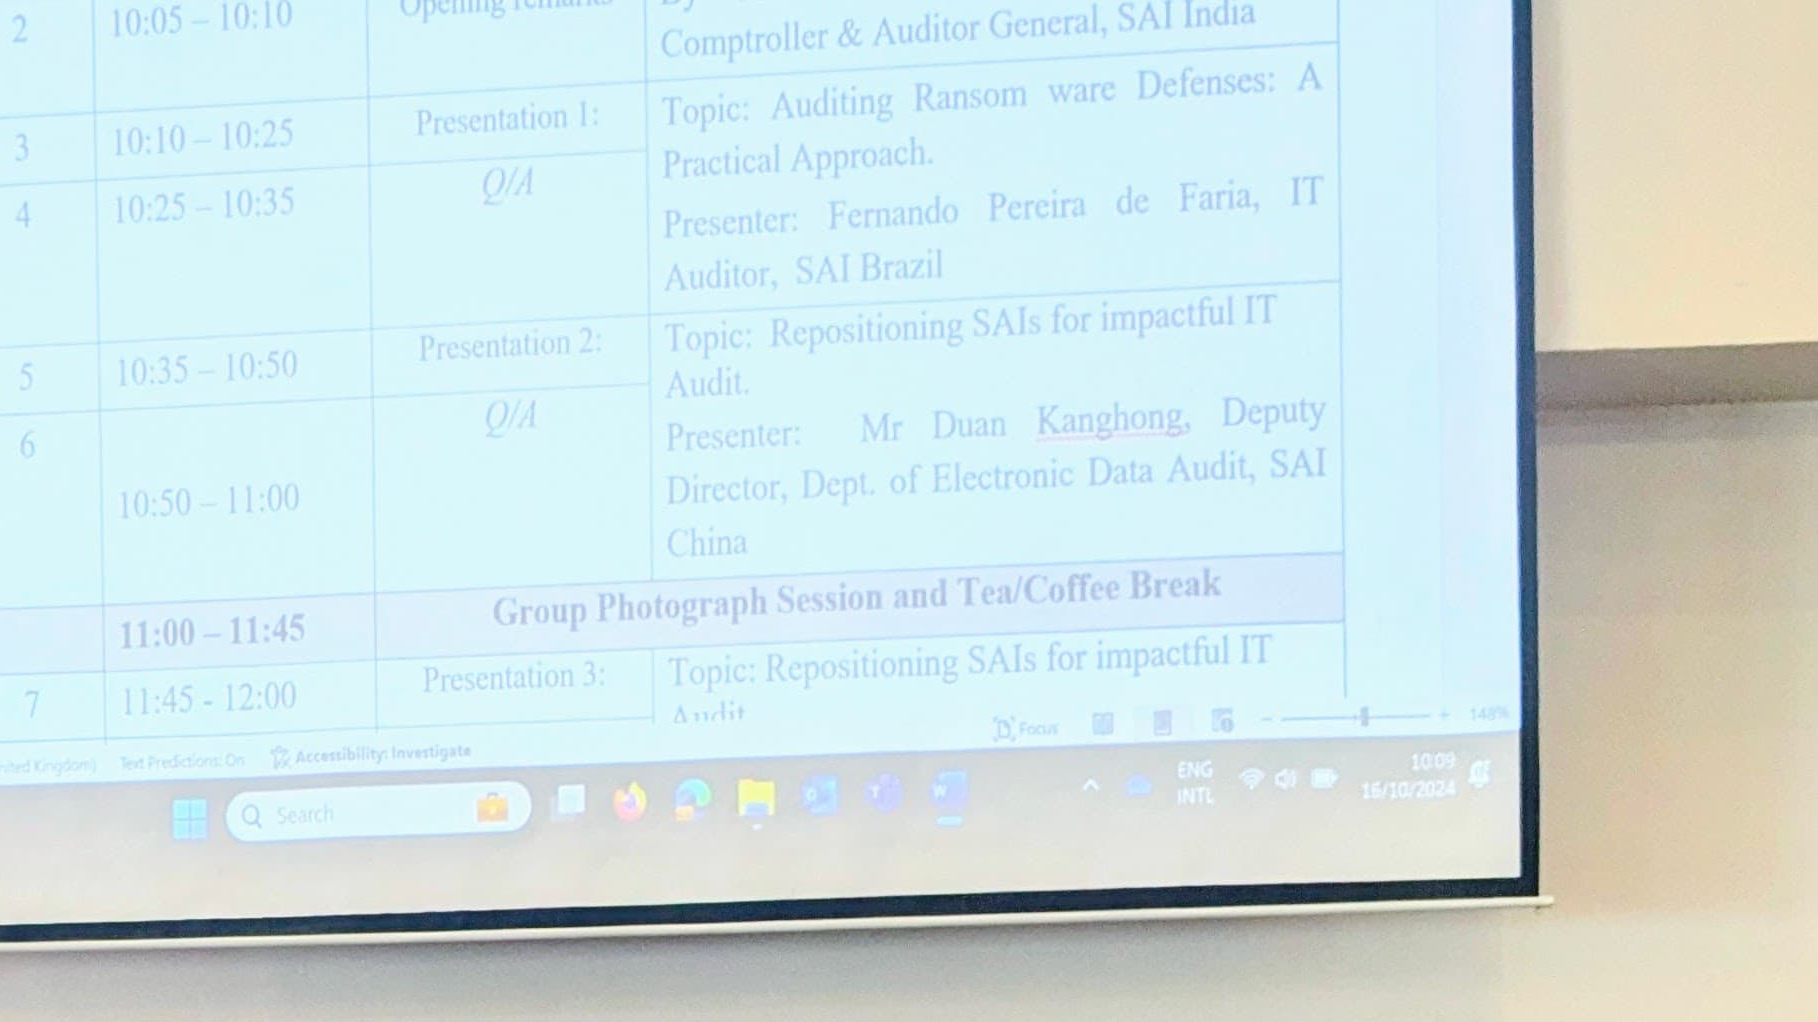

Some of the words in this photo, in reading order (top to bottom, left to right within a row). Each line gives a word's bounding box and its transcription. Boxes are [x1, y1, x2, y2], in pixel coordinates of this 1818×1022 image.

[11, 13, 30, 46] 2
[112, 4, 183, 40] 10:05
[219, 1, 293, 35] 10:10
[661, 19, 830, 63] Comptroller
[838, 23, 864, 49] &
[872, 13, 982, 47] Auditor
[989, 2, 1109, 40] General,
[1117, 0, 1174, 33] SAI
[1185, 0, 1256, 28] India
[662, 95, 750, 135] Topic:
[771, 83, 894, 124] Auditing
[914, 81, 1028, 114] Ransom
[1047, 77, 1117, 105] ware
[1136, 66, 1276, 102] Defenses:
[1296, 60, 1325, 92] A
[113, 123, 186, 158] 10:10
[222, 118, 295, 153] 10:25
[415, 101, 568, 138] Presentation
[578, 101, 600, 130] 1:
[15, 132, 31, 164] 3
[663, 142, 781, 181] Practical
[790, 136, 935, 180] Approach.
[482, 165, 536, 207] Q/A
[14, 200, 33, 230] 4
[114, 192, 186, 226] 10:25
[223, 186, 295, 221] 10:35
[664, 206, 799, 241] Presenter:
[829, 193, 959, 231] Fernando
[988, 189, 1087, 223] Pereira
[1115, 184, 1150, 217] de
[1179, 178, 1261, 215] Faria,
[1290, 175, 1325, 208] IT
[664, 257, 779, 296] Auditor,
[795, 253, 851, 286] SAI
[861, 248, 943, 284] Brazil
[418, 327, 572, 363] Presentation
[578, 326, 603, 356] 2:
[664, 321, 753, 362] Topic:
[770, 312, 964, 356] Repositioning
[972, 305, 1042, 339] SAIs
[1050, 302, 1091, 337] for
[1101, 294, 1235, 341] impactful
[1243, 292, 1278, 326] IT
[19, 361, 36, 392] 5
[117, 354, 189, 388] 10:35
[226, 349, 299, 384] 10:50
[665, 366, 751, 400] Audit.
[484, 397, 538, 439] Q/A
[666, 420, 802, 455] Presenter:
[860, 411, 904, 444] Mr
[931, 408, 1007, 441] Duan
[1037, 401, 1192, 441] Kanghong,
[1222, 396, 1327, 434] Deputy
[20, 429, 37, 460] 6
[666, 471, 790, 507] Director,
[800, 466, 877, 506] Dept.
[889, 463, 923, 496] of
[932, 457, 1076, 495] Electronic
[1087, 454, 1154, 488] Data
[1166, 448, 1257, 486] Audit,
[1269, 446, 1327, 480] SAI
[119, 488, 192, 521] 10:50
[228, 482, 301, 516] 11:00
[665, 525, 749, 560] China
[492, 596, 588, 632] Group
[595, 586, 767, 627] Photograph
[777, 580, 883, 616] Session
[893, 577, 948, 610] and
[957, 573, 1122, 609] Tea/Coffee
[1130, 566, 1223, 602] Break
[120, 616, 195, 650] 11:00
[230, 611, 306, 647] 11:45
[422, 659, 574, 695] Presentation
[582, 658, 606, 688] 3:
[667, 655, 756, 693] Topic:
[764, 645, 959, 690] Repositioning
[968, 642, 1038, 676] SAIs
[1046, 637, 1088, 672] for
[1096, 632, 1231, 678] impactful
[1239, 632, 1275, 666] IT
[24, 688, 40, 720] 7
[124, 684, 194, 717] 11:45
[225, 680, 298, 714] 12:00
[1019, 720, 1059, 738] Focus
[34, 756, 98, 776] Kingdom)
[119, 755, 145, 770] Text
[147, 753, 221, 771] Predictions:
[225, 753, 246, 768] On
[295, 748, 388, 766] Accessibility:
[391, 744, 471, 763] Investigate
[1177, 759, 1213, 779] ENG
[1410, 751, 1456, 772] 10:09
[1175, 787, 1214, 807] INTL
[1361, 778, 1457, 802] 16/10/2024
[276, 803, 334, 827] Search
